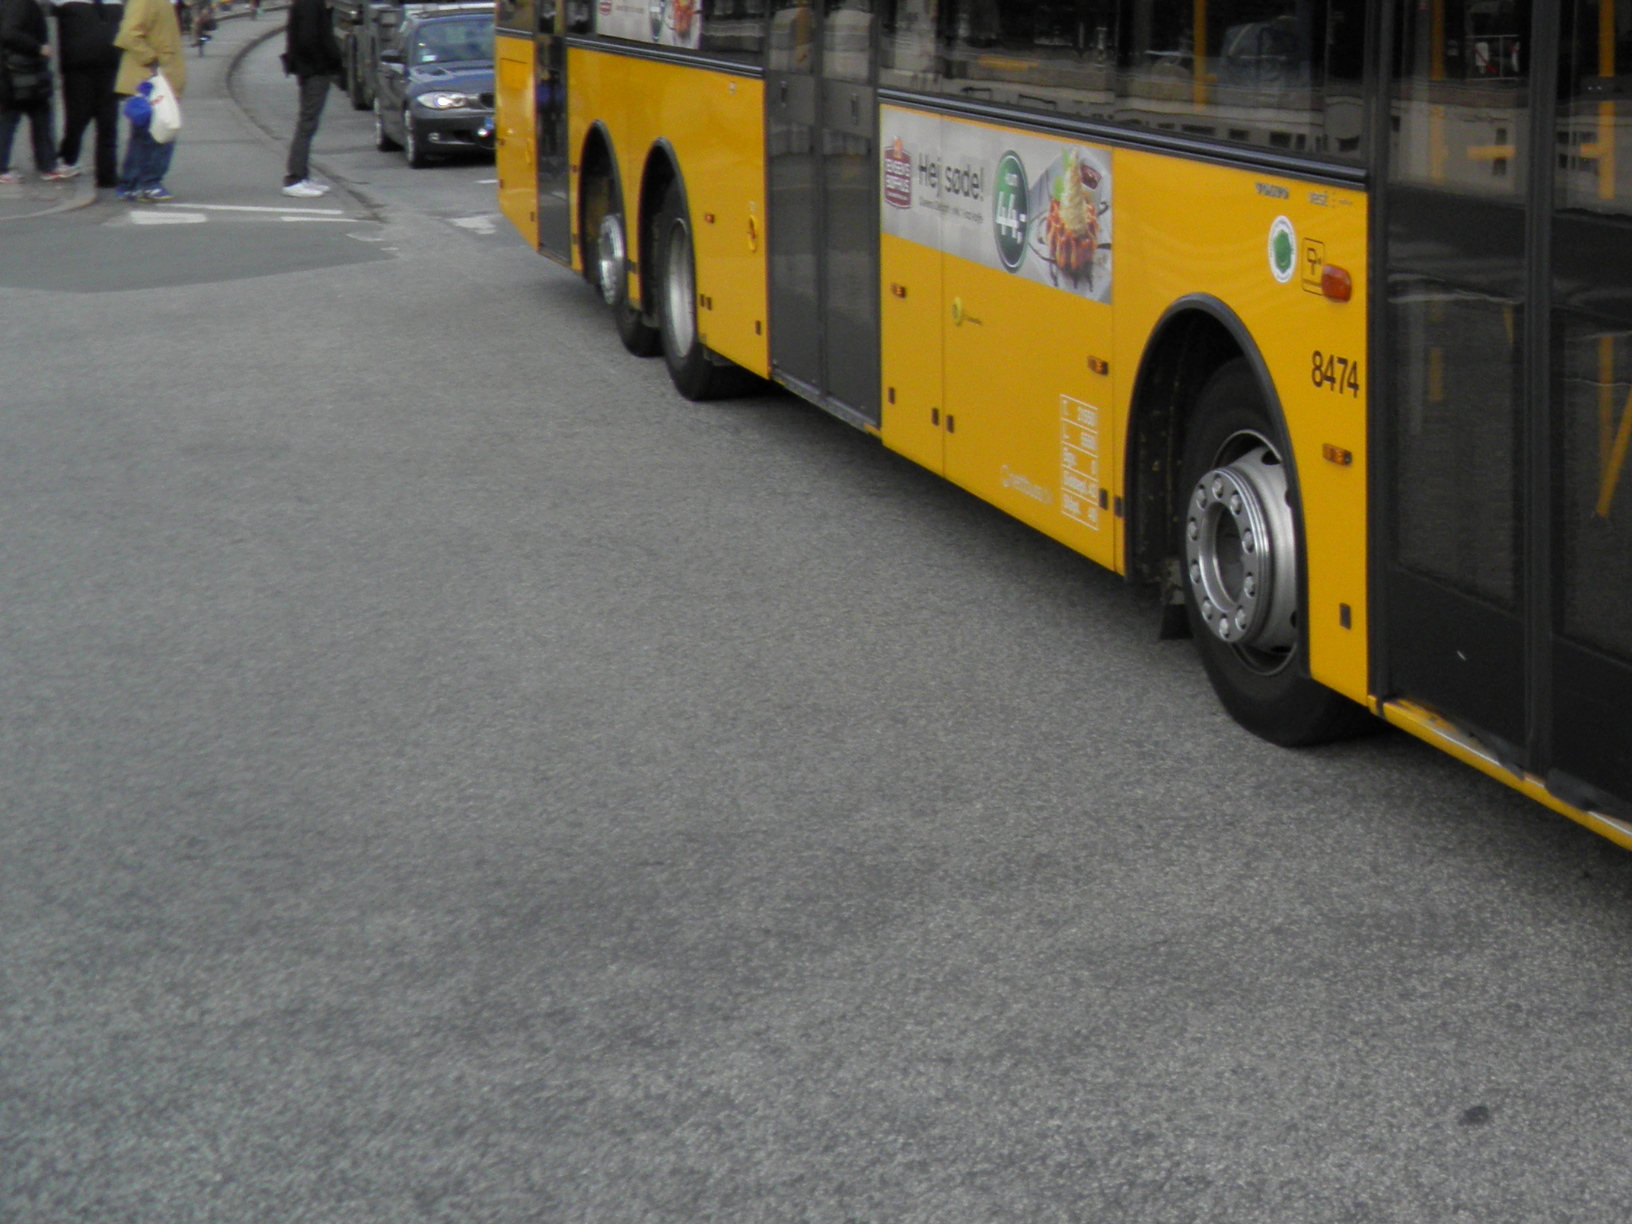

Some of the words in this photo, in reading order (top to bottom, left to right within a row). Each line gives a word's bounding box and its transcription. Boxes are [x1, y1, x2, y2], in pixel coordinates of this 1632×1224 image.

[918, 152, 943, 197] Hej
[944, 162, 985, 202] søde!
[1311, 350, 1360, 398] 8474
